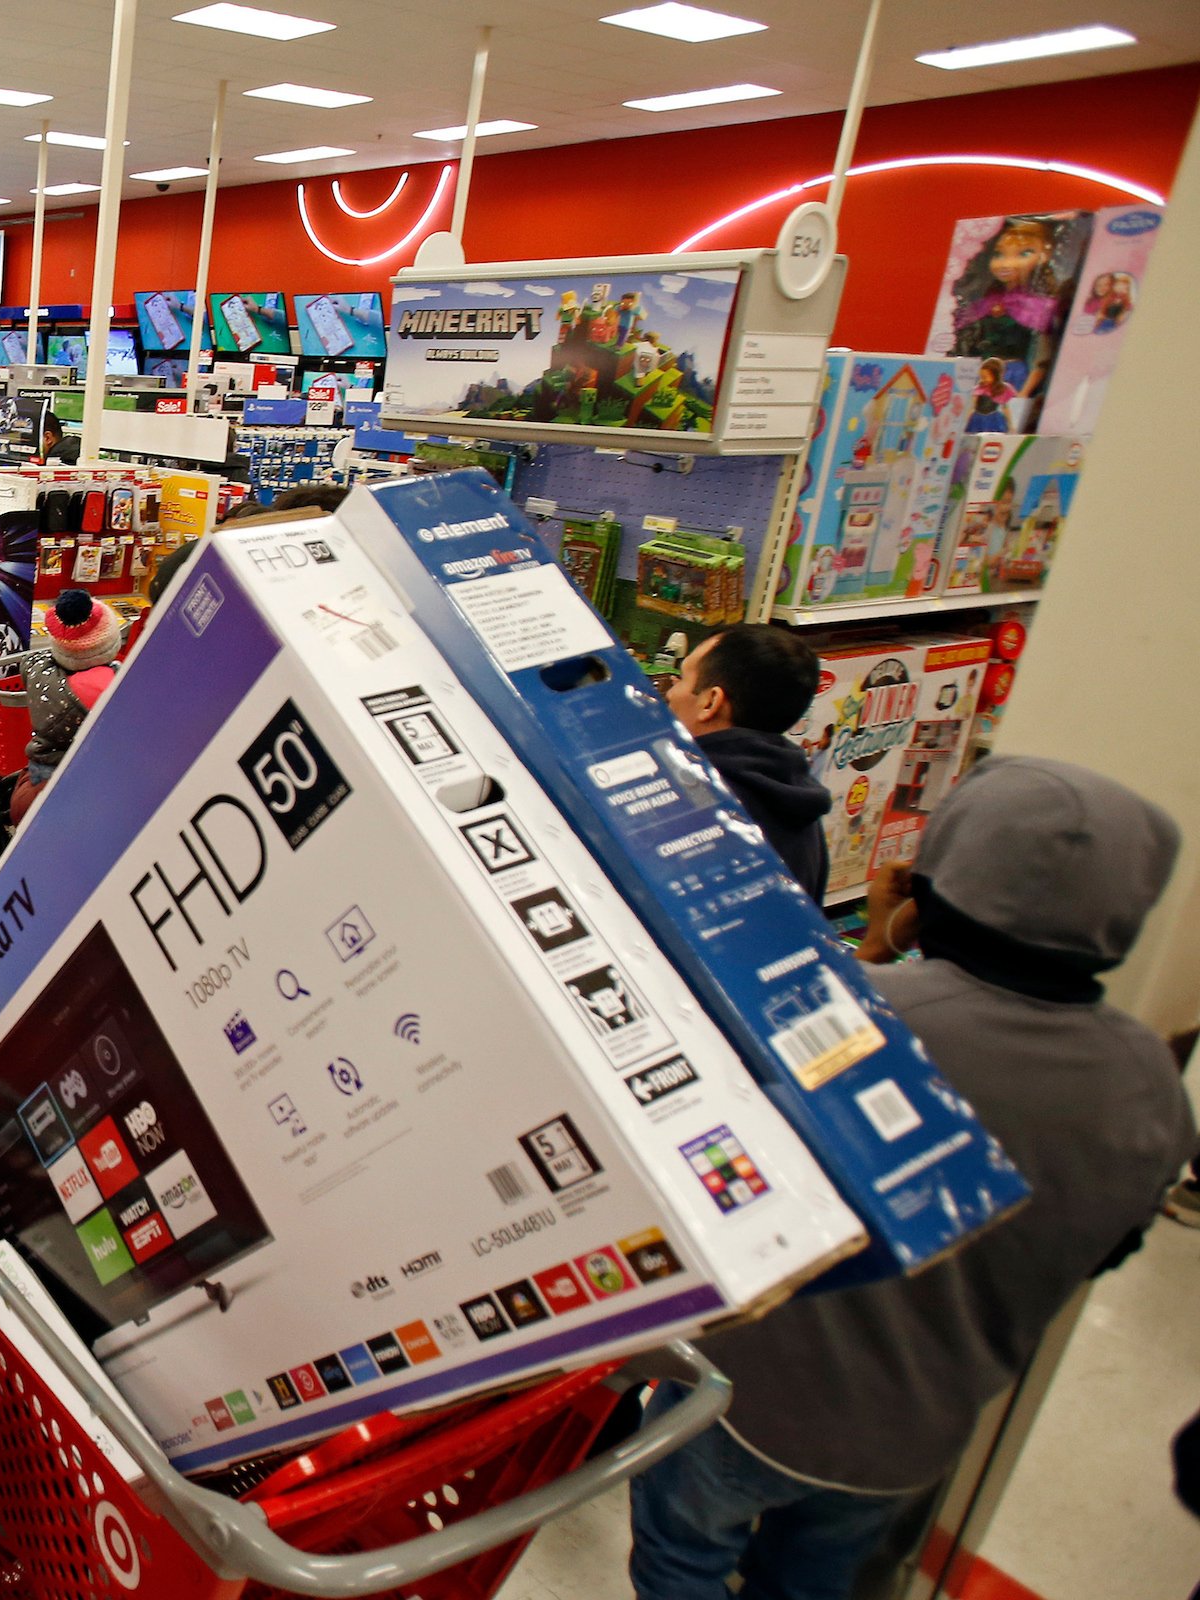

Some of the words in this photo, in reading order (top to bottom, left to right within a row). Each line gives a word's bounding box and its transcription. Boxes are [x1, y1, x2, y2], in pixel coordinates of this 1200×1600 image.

[791, 235, 820, 258] E34
[398, 307, 544, 340] MINECRAFT
[157, 401, 181, 413] Sale!
[308, 389, 330, 399] Sale!
[237, 534, 278, 544] SHARP
[436, 513, 510, 541] element
[247, 544, 309, 573] FHD
[860, 682, 918, 728] DINER
[402, 720, 418, 740] 5
[606, 788, 637, 807] VOICE
[635, 778, 672, 799] REMOTE
[625, 799, 652, 816] WITH
[650, 790, 681, 808] ALEXA
[657, 824, 726, 859] CONNECTIONS
[129, 793, 268, 973] FHD
[3, 876, 35, 931] TV
[184, 963, 233, 1010] 1080p
[226, 937, 252, 969] TV
[650, 1059, 696, 1092] FRONT
[123, 1101, 157, 1139] HBO
[135, 1123, 166, 1157] NOW
[537, 1132, 557, 1158] 5
[553, 1158, 573, 1175] MAX
[58, 1166, 91, 1201] NETFLIX
[160, 1173, 197, 1207] amazon
[119, 1197, 150, 1227] WATCH
[90, 1235, 118, 1262] hulu
[131, 1218, 163, 1251] ESPN
[471, 1209, 557, 1259] LC-50LB481U
[400, 1250, 443, 1279] HDMI
[365, 1273, 391, 1292] dts
